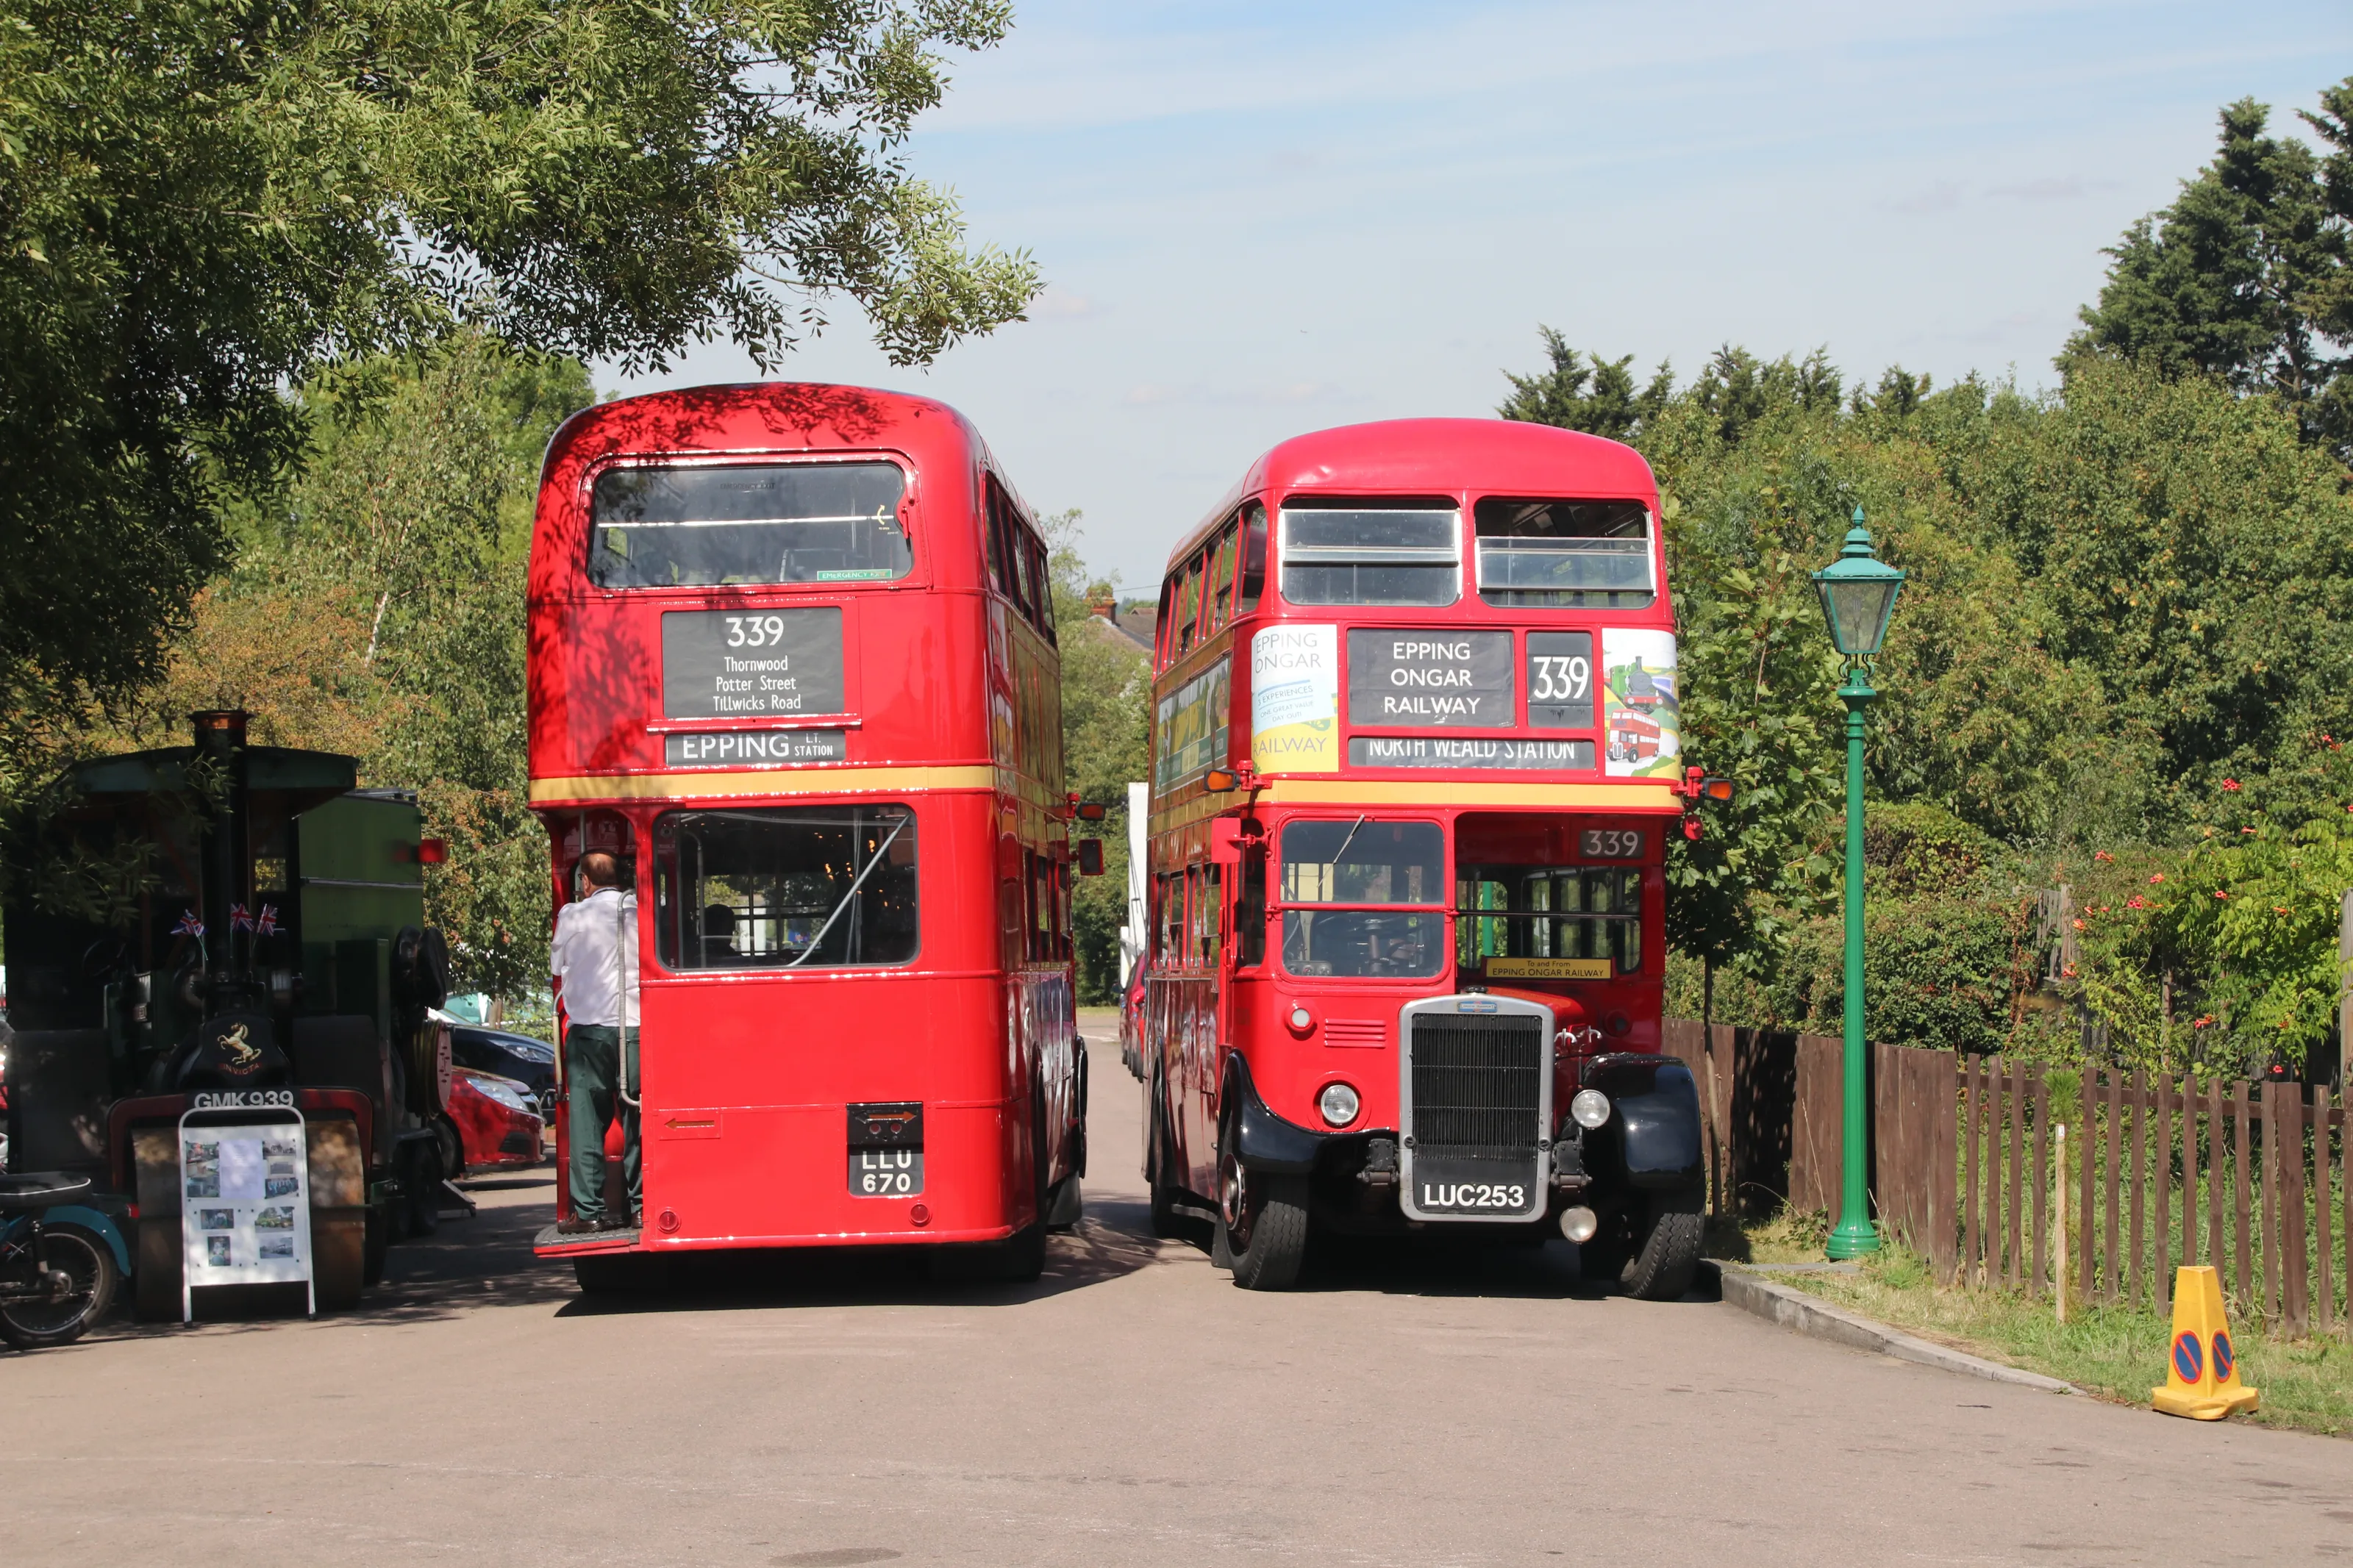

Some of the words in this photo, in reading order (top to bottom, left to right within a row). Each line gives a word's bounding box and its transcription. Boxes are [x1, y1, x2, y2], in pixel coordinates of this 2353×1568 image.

[822, 571, 868, 579] EMERGENCY
[725, 615, 785, 647] 339
[1256, 632, 1318, 654] EPPING
[1393, 642, 1471, 660] EPPING
[724, 655, 788, 672] Thornwood
[1255, 653, 1322, 674] ONGAR
[716, 676, 753, 692] Potter
[760, 675, 796, 691] Street
[1390, 668, 1473, 687] ONGAR
[1533, 656, 1589, 700] 339
[713, 695, 765, 712] Tillwicks
[771, 693, 801, 709] Road
[1258, 698, 1262, 706] 3
[1262, 685, 1313, 704] EXPERIENCES
[1260, 708, 1271, 718] ONE
[1273, 704, 1293, 714] GREAT
[1295, 700, 1314, 709] VALUE
[1384, 696, 1481, 715] RAILWAY
[1272, 713, 1285, 723] DAY
[1287, 712, 1302, 720] OUT!
[682, 734, 790, 759] EPPING
[806, 733, 821, 744] L.T.
[1253, 737, 1327, 756] RAILWAY
[794, 745, 833, 756] STATION
[1369, 739, 1425, 757] NORTH
[1434, 740, 1496, 759] WEALD
[1504, 740, 1575, 759] STATION
[1586, 829, 1638, 856] 339
[1493, 967, 1525, 976] EPPING
[1528, 968, 1563, 977] ONGAR
[1565, 969, 1604, 978] RAILWAY
[224, 1063, 260, 1075] INVICTA
[194, 1092, 246, 1108] GMK
[249, 1090, 294, 1107] 939
[862, 1150, 912, 1170] LLU
[863, 1173, 911, 1193] 670
[1424, 1184, 1524, 1207] LUC253
